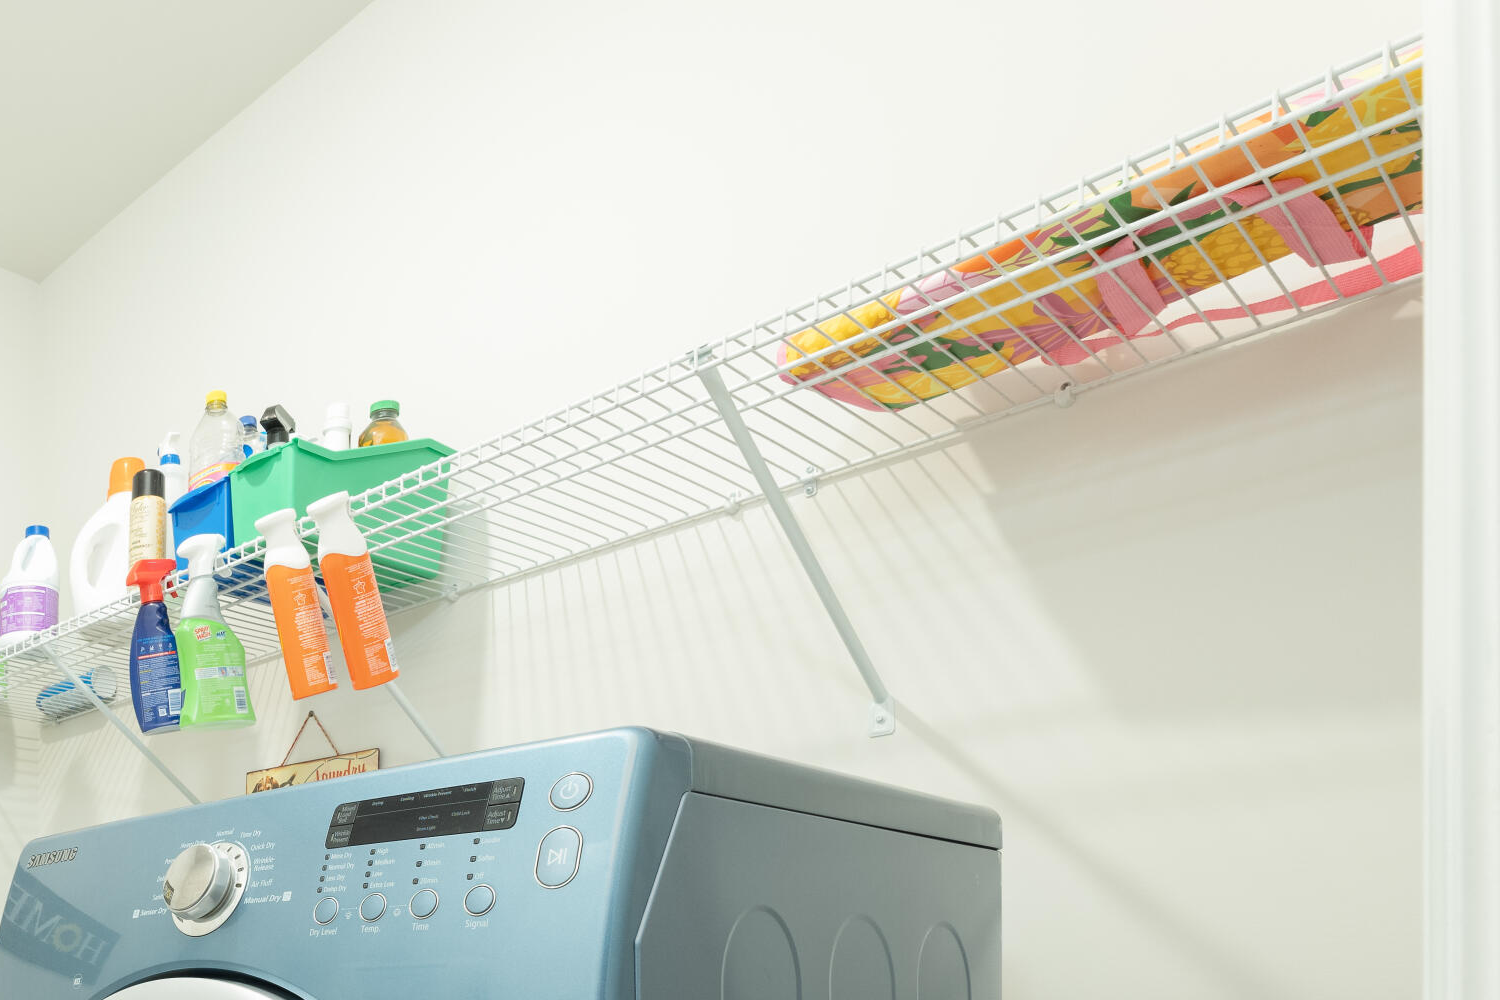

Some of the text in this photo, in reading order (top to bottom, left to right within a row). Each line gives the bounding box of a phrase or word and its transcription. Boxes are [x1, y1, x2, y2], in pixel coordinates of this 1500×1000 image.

[487, 810, 506, 819] Adjust
[252, 829, 261, 838] Dry
[251, 841, 275, 851] Quick Dry
[27, 846, 79, 870] SAMSUNG
[244, 894, 281, 905] Manual Dry
[158, 907, 167, 915] Dry
[412, 921, 430, 931] Time
[465, 918, 489, 930] Signal
[309, 926, 338, 938] Dry Level
